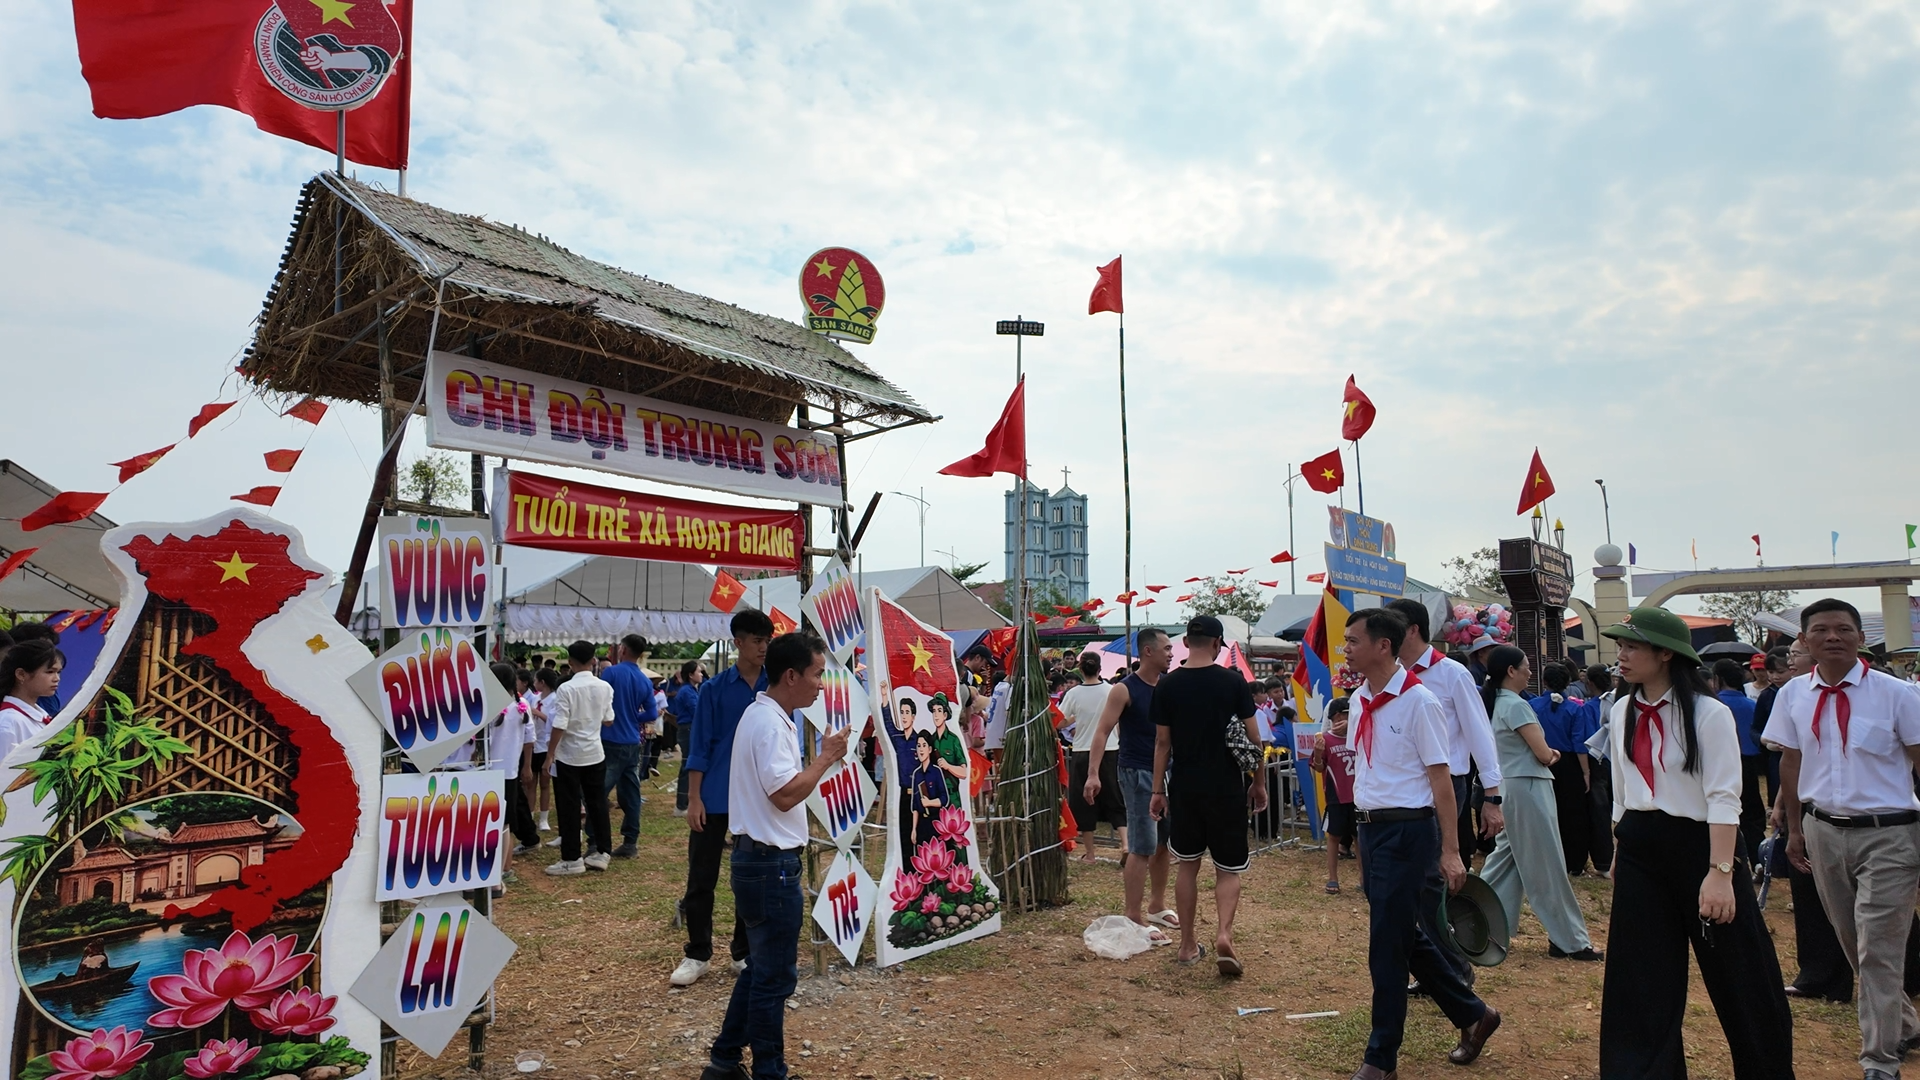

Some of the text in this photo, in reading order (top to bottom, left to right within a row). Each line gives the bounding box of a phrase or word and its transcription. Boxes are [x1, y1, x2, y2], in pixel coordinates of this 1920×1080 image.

[260, 34, 272, 62] THANH
[266, 61, 283, 81] NIÊN
[282, 78, 308, 97] CỘNG
[344, 88, 359, 102] CHÍ
[358, 75, 376, 94] MINH
[445, 369, 841, 487] CHI ĐỘI TRUNG SƠN
[388, 518, 486, 626] VỮNG
[513, 485, 795, 559] TUỔI TRẺ XÃ HOẠT GIANG
[812, 568, 865, 653] VƯƠN
[381, 627, 483, 750] BƯỚC
[385, 775, 500, 891] TƯƠNG
[827, 851, 861, 946] TRẺ
[400, 909, 470, 1013] LAI
